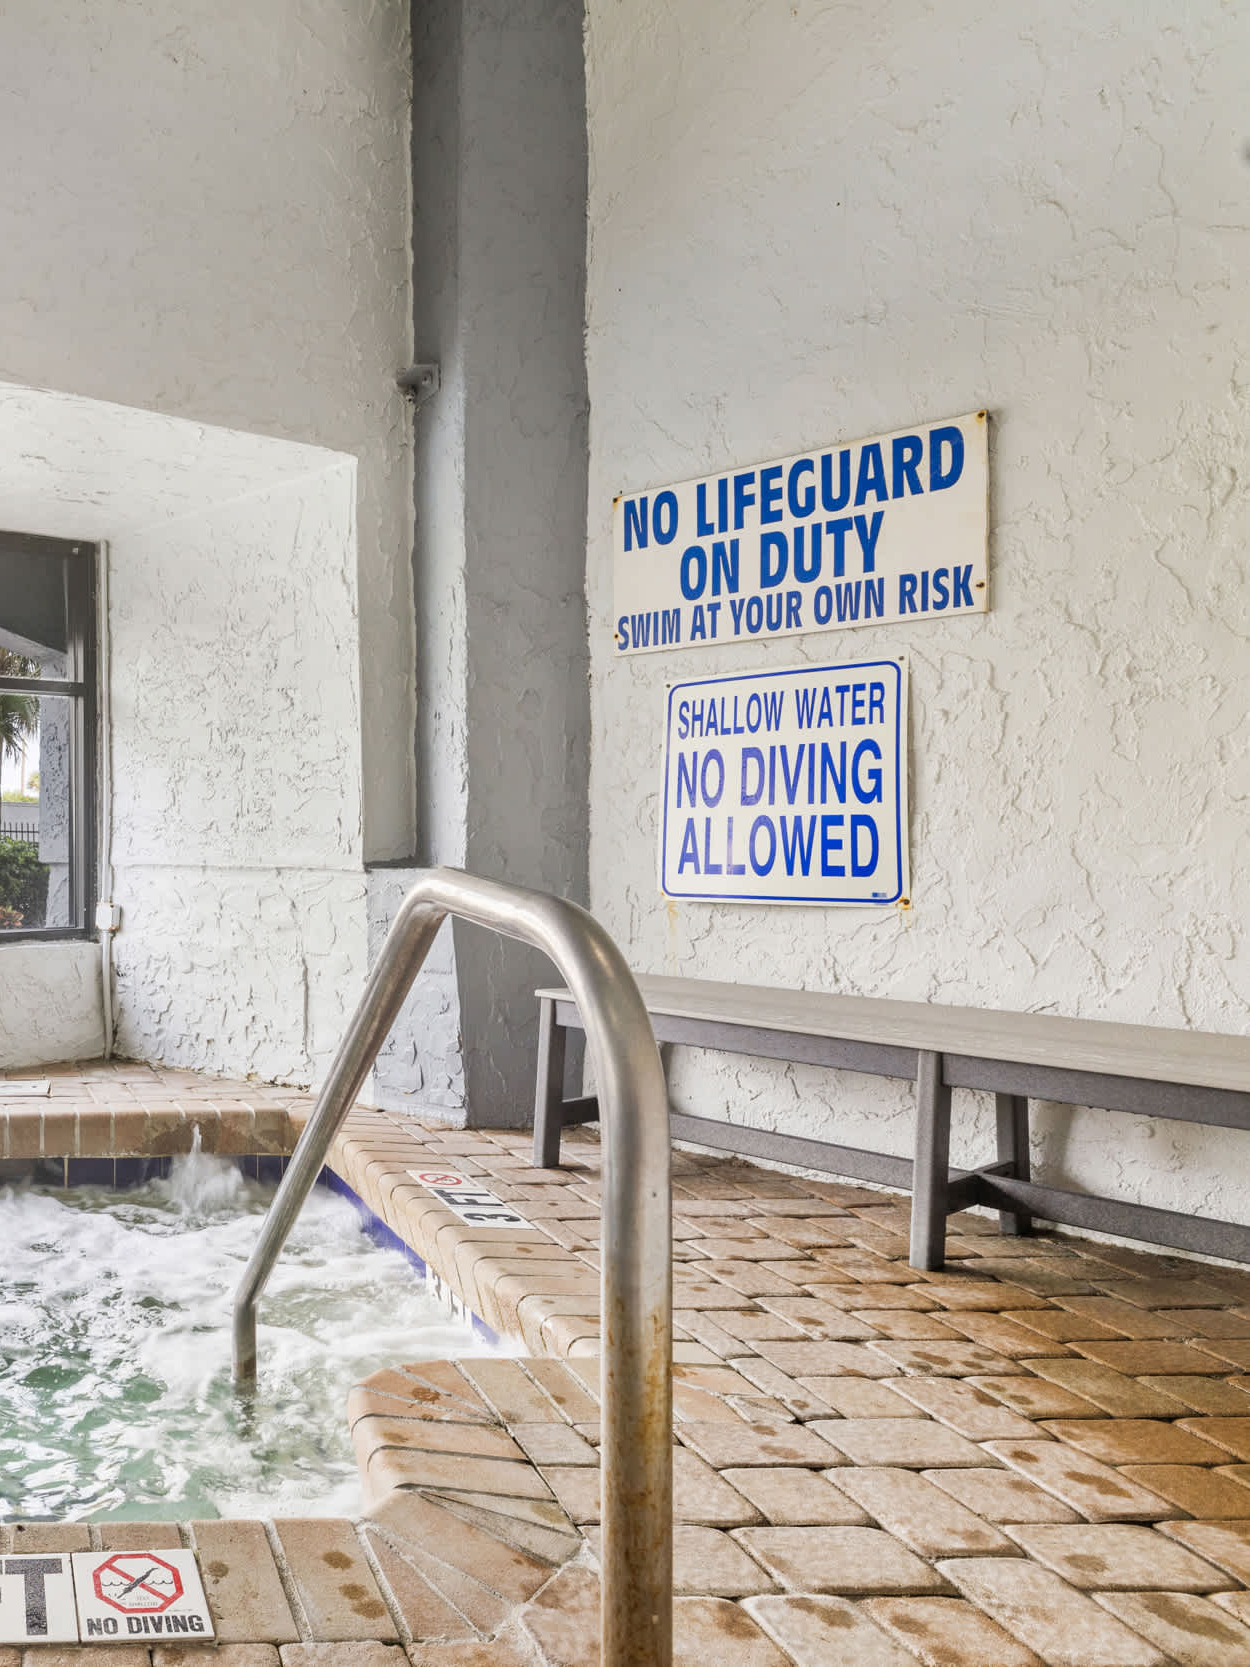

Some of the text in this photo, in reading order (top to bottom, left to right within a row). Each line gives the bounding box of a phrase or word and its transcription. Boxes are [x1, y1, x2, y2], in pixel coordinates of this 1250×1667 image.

[623, 425, 965, 552] NO LIFEGUARD
[679, 510, 885, 601] ON DUTY
[617, 563, 975, 651] SWIM AT YOUR OWN RISK
[677, 681, 885, 740] SHALLOW WATER
[676, 738, 883, 808] NO DIVING
[677, 813, 879, 878] ALLOWED
[434, 1189, 521, 1223] 3 FT
[86, 1614, 205, 1636] NO DIVING
